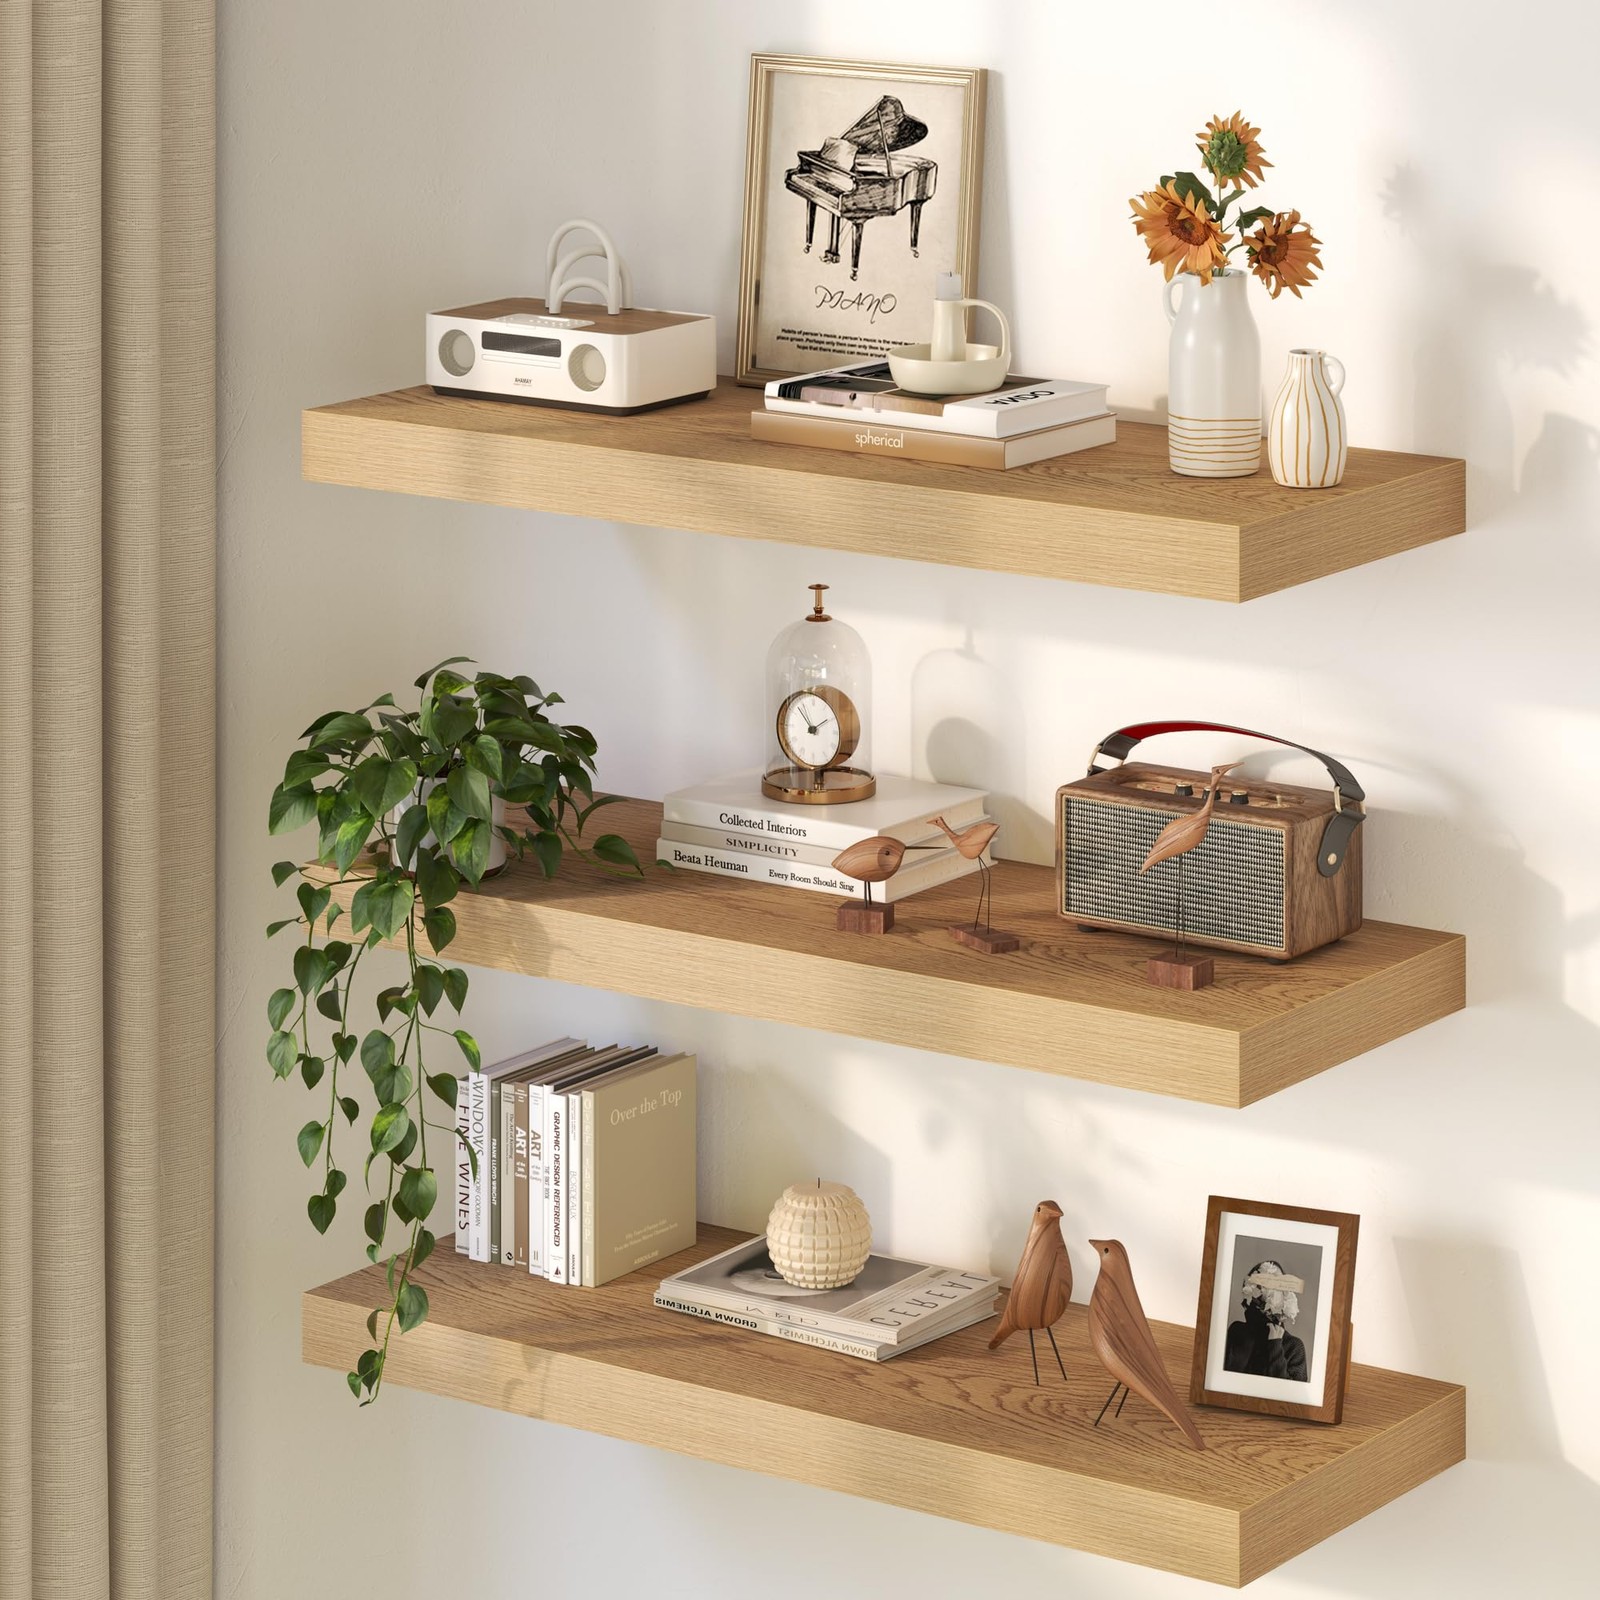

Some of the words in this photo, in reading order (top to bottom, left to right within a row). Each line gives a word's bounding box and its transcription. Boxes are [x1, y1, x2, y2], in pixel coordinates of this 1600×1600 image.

[815, 285, 897, 324] PIANO
[855, 429, 904, 449] spherical
[719, 813, 764, 831] Collected
[767, 820, 807, 837] Interiors
[674, 850, 701, 865] Beata
[704, 855, 749, 873] Heuman
[726, 837, 800, 857] SIMPLICITY
[769, 869, 788, 881] Every
[790, 873, 811, 884] Room
[812, 876, 837, 889] Should
[839, 881, 855, 893] Sing
[472, 1080, 484, 1156] WINDOWS
[610, 1106, 638, 1126] Over
[640, 1096, 657, 1114] the
[660, 1089, 682, 1107] Top
[459, 1105, 469, 1151] FINE
[516, 1126, 527, 1158] ART
[531, 1130, 541, 1160] ART
[459, 1163, 469, 1230] WINES
